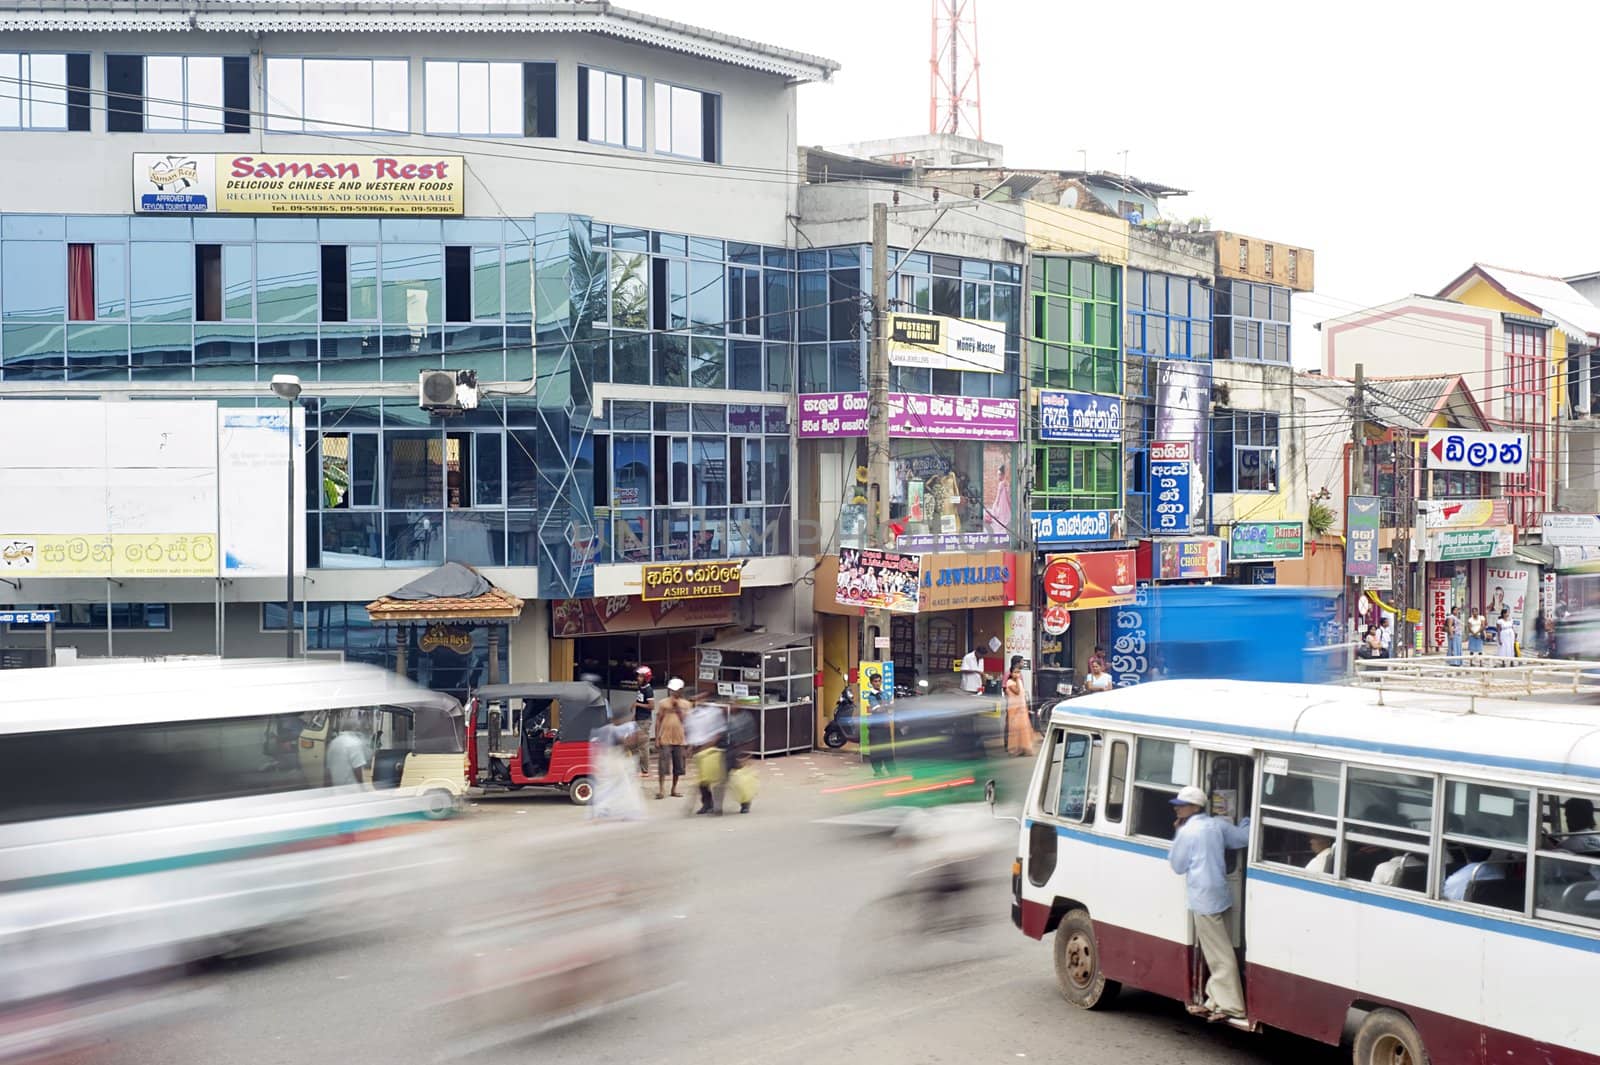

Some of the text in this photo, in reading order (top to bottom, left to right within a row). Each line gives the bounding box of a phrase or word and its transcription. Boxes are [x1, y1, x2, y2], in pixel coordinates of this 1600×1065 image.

[231, 156, 449, 179] Saman Rest
[226, 180, 454, 191] DELICIOUS CHINESE AND WESTERN FOODS
[156, 194, 185, 202] APPROVED
[226, 193, 287, 201] RECEPTION
[291, 193, 323, 201] HALLS
[328, 193, 351, 201] AND
[400, 194, 453, 202] AVAILABLE
[143, 203, 164, 211] CEYLON
[895, 321, 933, 333] WESTERN
[906, 331, 933, 341] UNION
[957, 340, 996, 354] Money Master
[1446, 435, 1523, 467] ඩිලාන්
[1184, 543, 1203, 555] BEST
[1180, 556, 1207, 568] CHOICE
[936, 564, 1010, 587] JEWELLERS
[1488, 568, 1527, 580] TULIP
[663, 584, 724, 597] ASIRI HOTEL
[1434, 591, 1447, 649] PHARMACY
